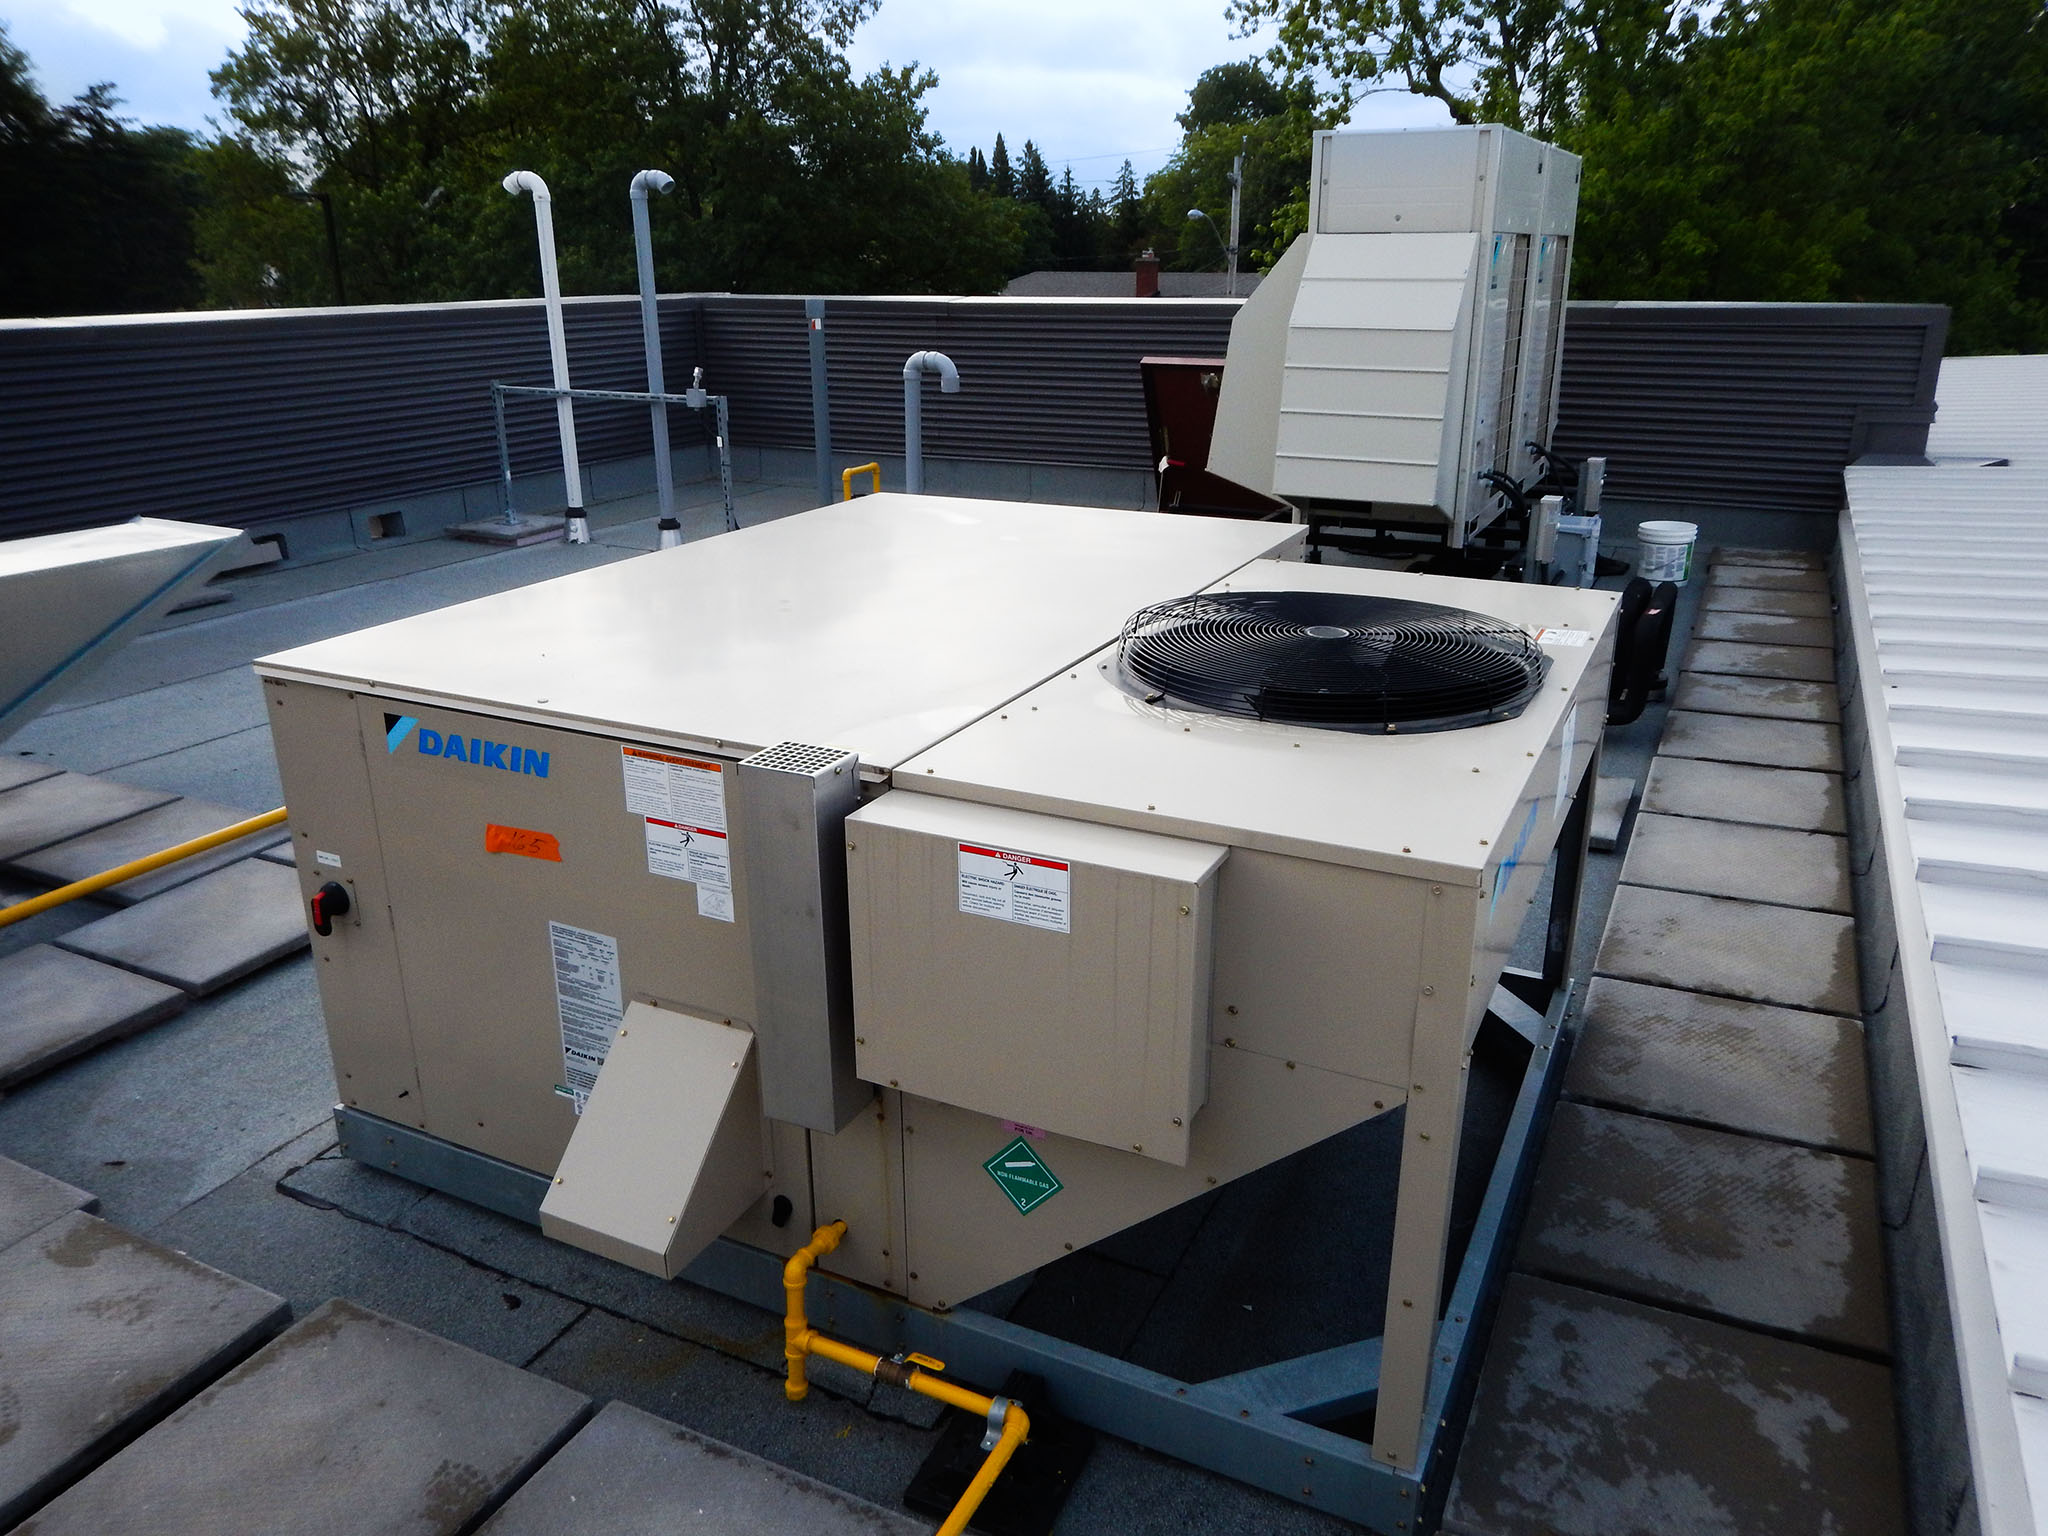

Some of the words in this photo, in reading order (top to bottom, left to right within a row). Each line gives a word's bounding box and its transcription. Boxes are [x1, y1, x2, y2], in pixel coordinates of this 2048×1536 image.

[418, 727, 551, 778] DAIKIN
[1002, 852, 1032, 864] DANGER
[571, 1050, 596, 1062] DAIKIN
[1008, 1173, 1038, 1186] FLAMMABLE
[1038, 1181, 1049, 1189] GAS
[1020, 1198, 1027, 1207] 2
